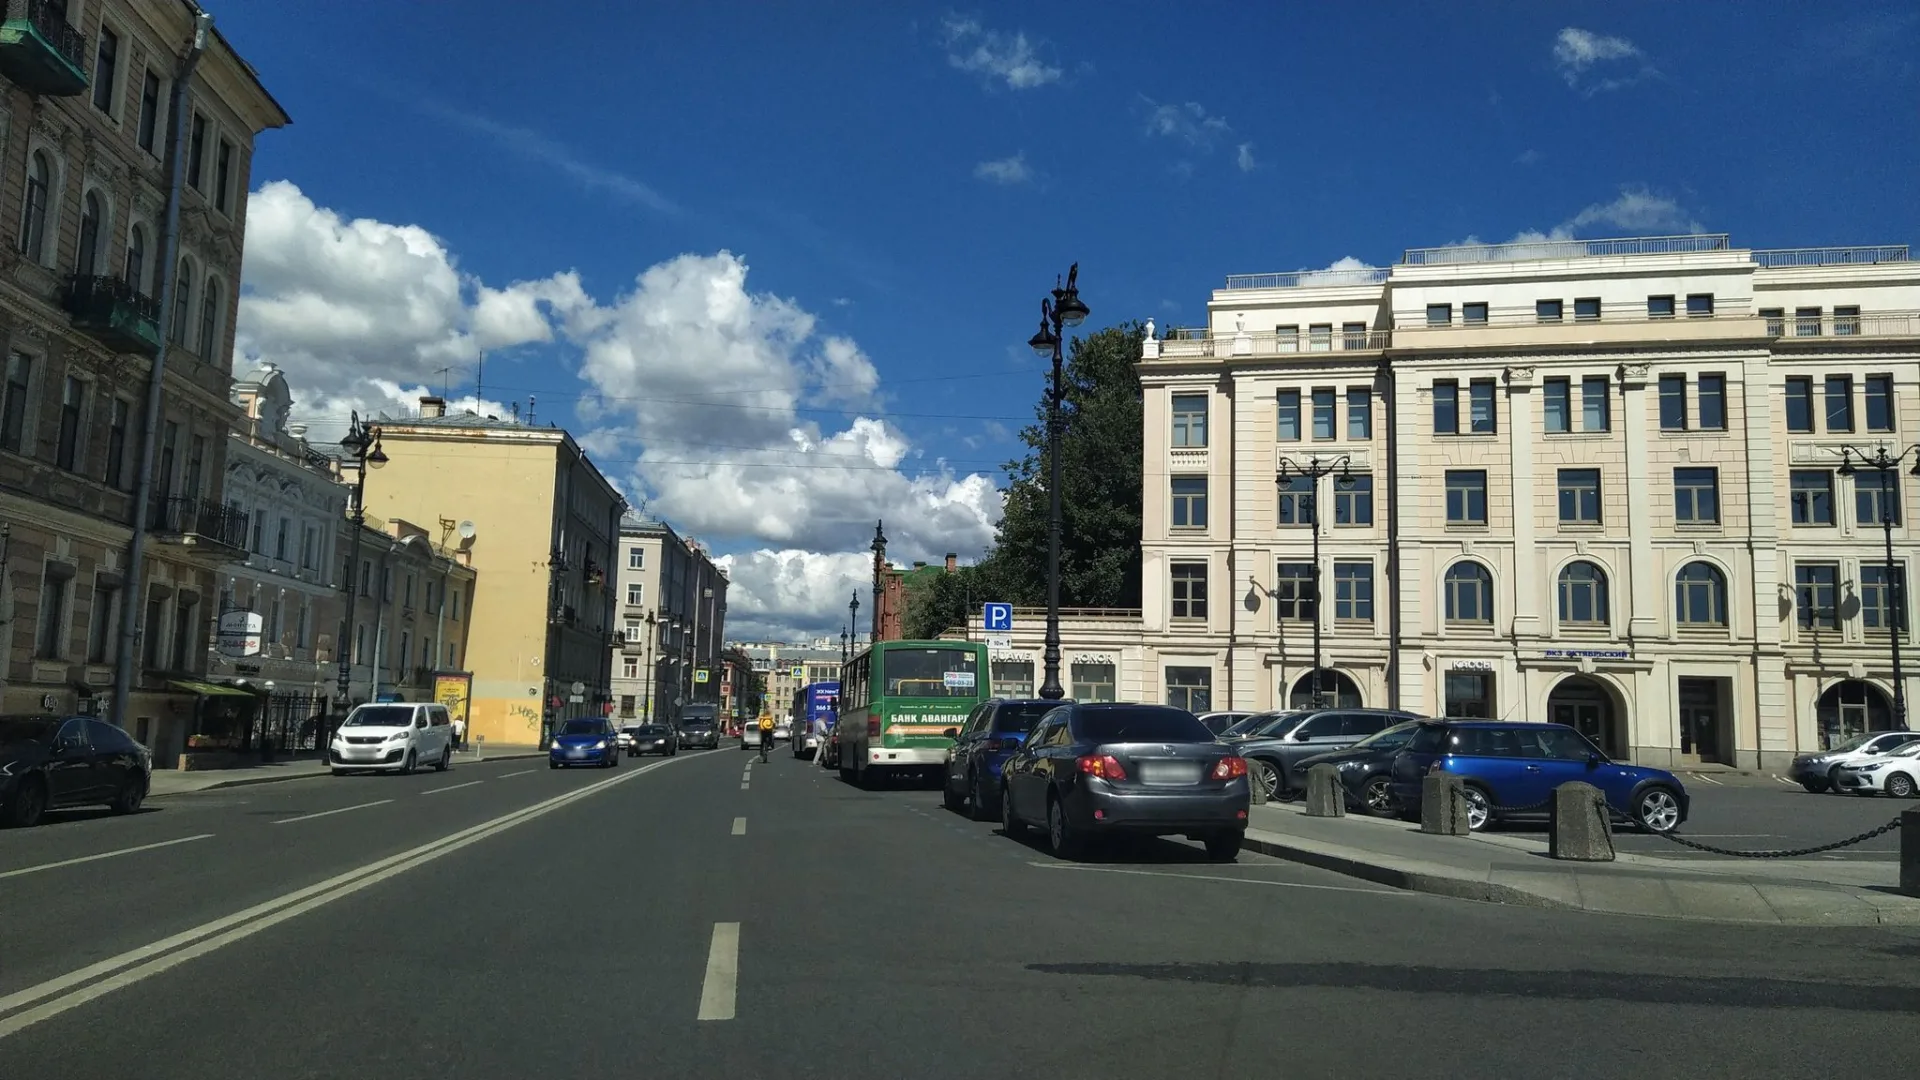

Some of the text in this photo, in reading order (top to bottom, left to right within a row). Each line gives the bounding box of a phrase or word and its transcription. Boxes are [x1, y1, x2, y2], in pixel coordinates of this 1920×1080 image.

[992, 606, 1007, 628] P
[991, 651, 1034, 661] HUAWEI
[1073, 653, 1114, 663] HONOR
[1453, 659, 1492, 669] КАССЫ
[891, 714, 918, 723] БАНК
